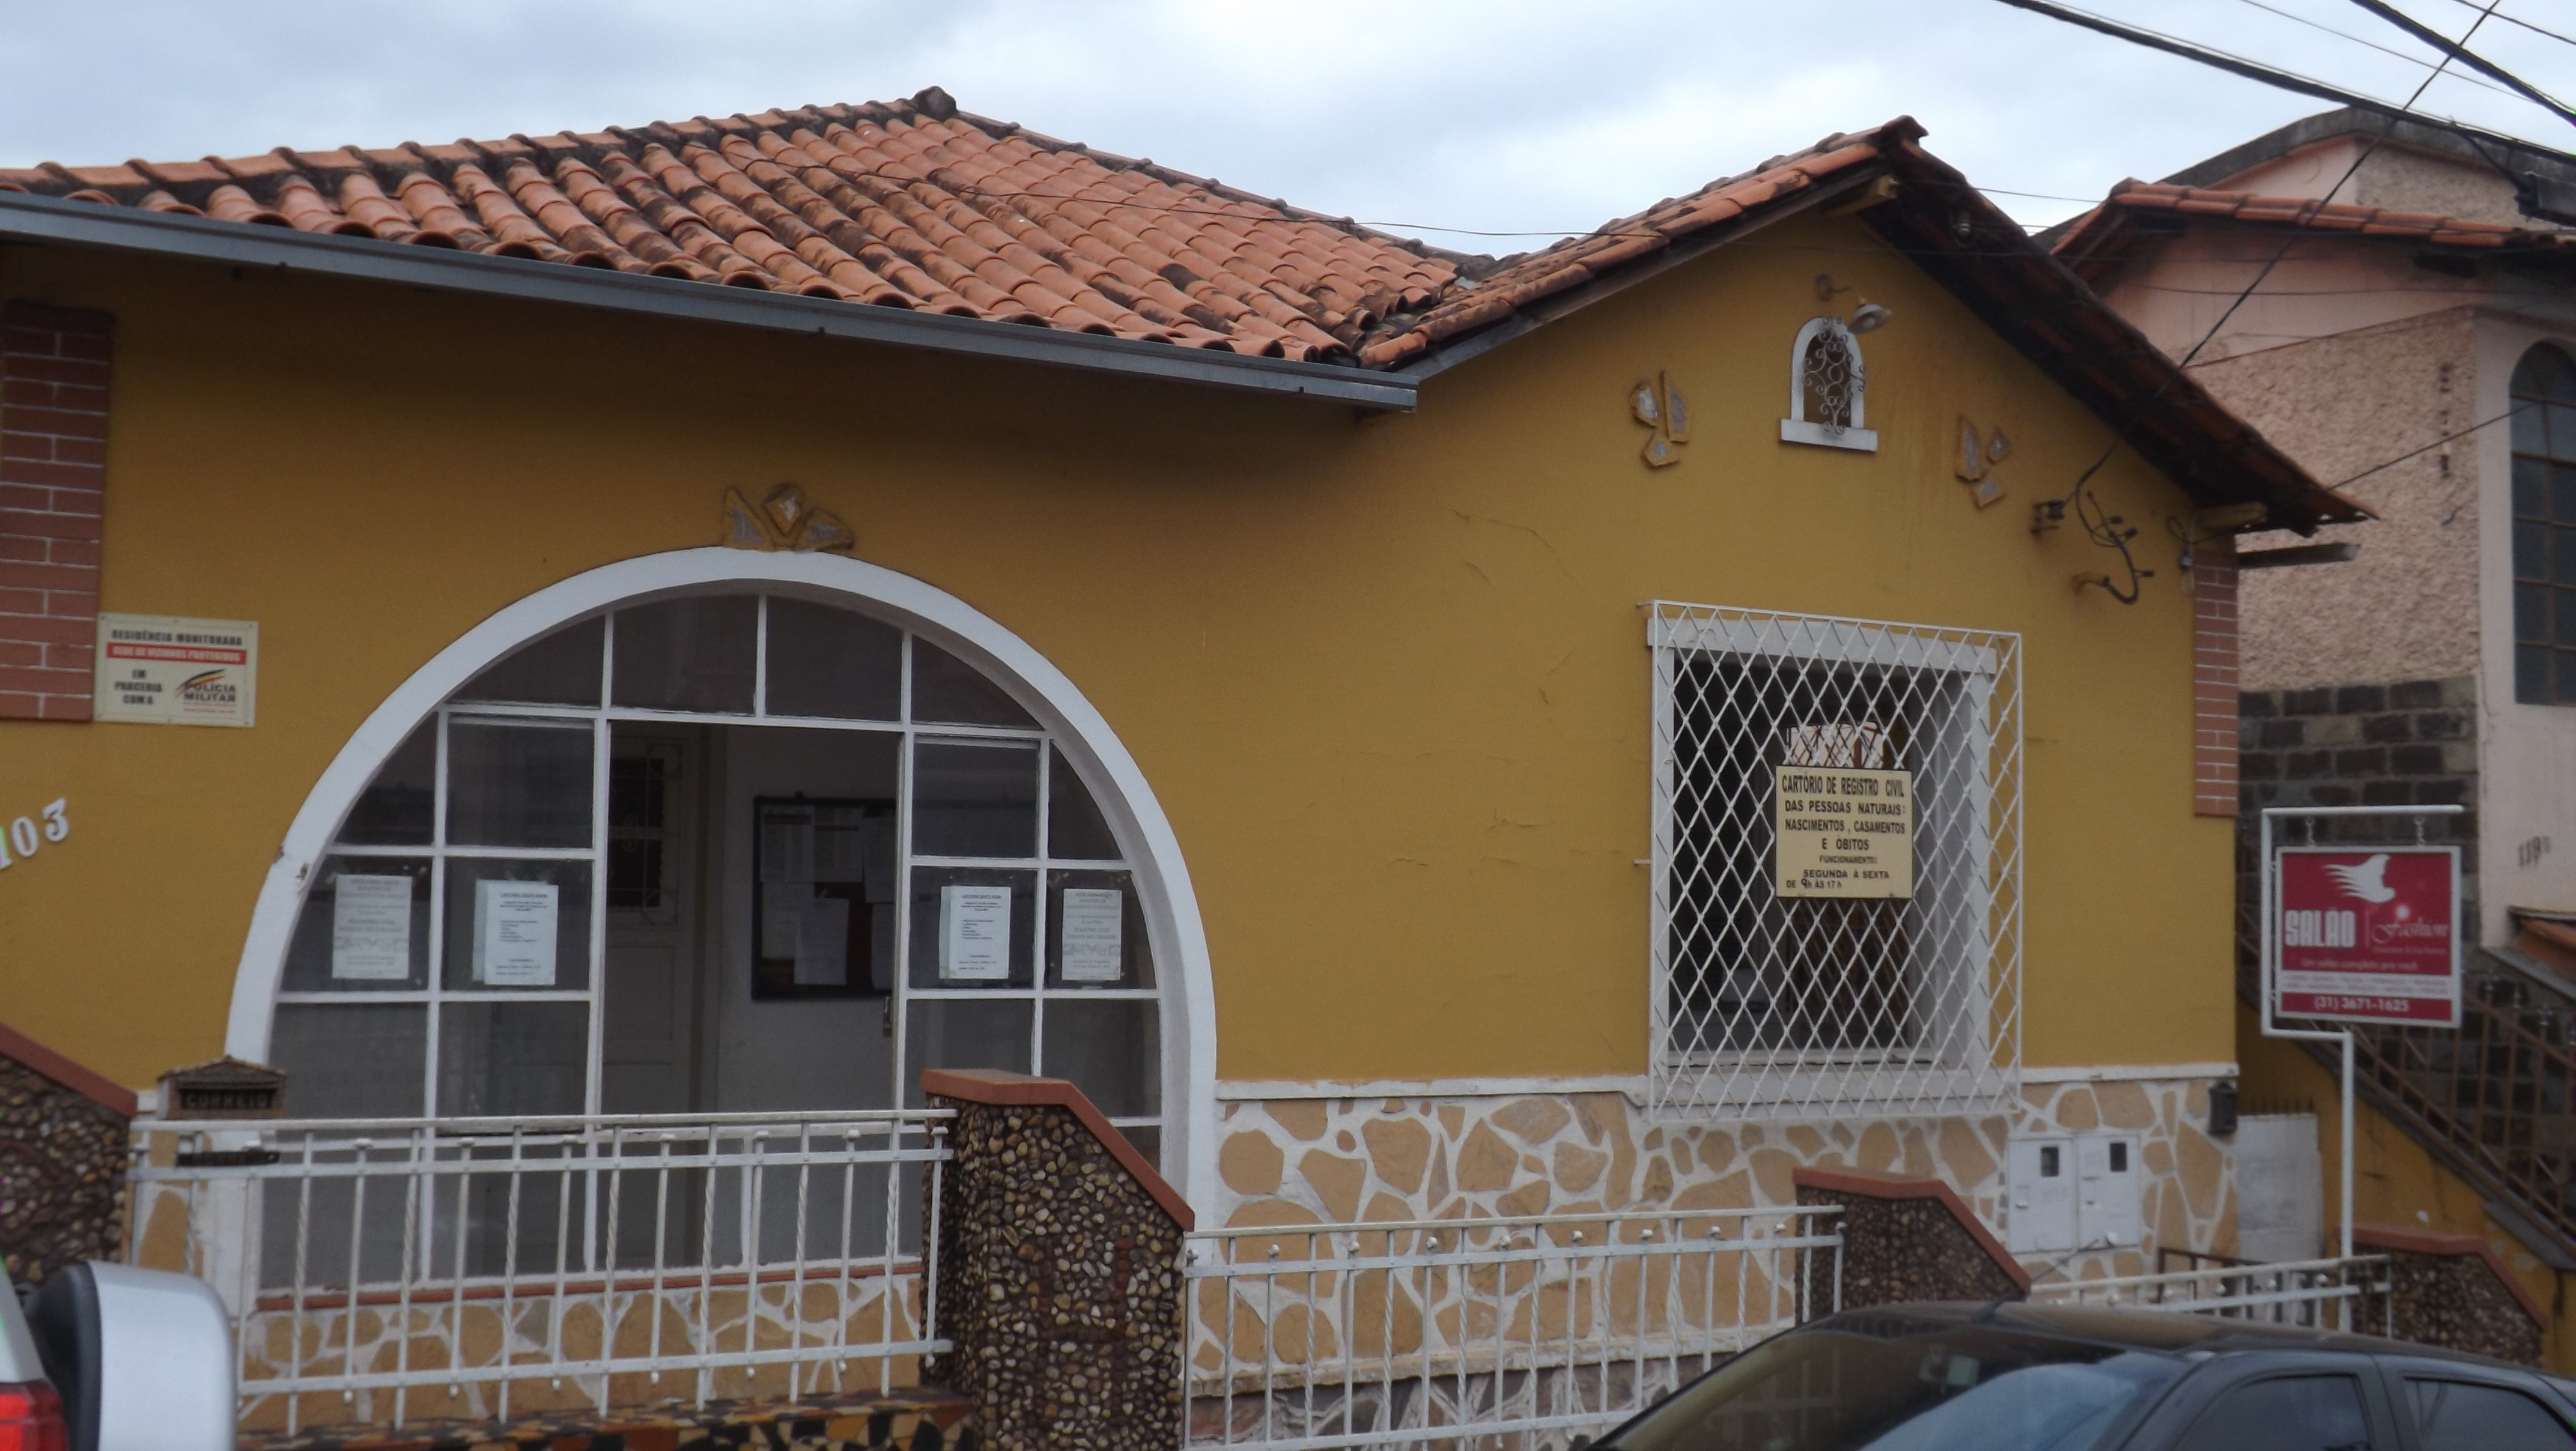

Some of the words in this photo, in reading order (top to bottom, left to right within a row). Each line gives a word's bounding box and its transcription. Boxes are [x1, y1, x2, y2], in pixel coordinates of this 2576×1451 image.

[184, 692, 236, 702] MILITAR
[1782, 772, 1823, 794] CARTÓRIO
[1826, 776, 1836, 795] DE
[1841, 777, 1879, 796] REGISTRO
[1885, 779, 1905, 798] CIVIL
[1785, 799, 1803, 812] DAS
[1809, 800, 1851, 813] PESSOAS
[1854, 820, 1906, 834] CASAMENTOS
[1821, 838, 1827, 850] E
[1803, 869, 1848, 878] SEGUNDA
[1863, 870, 1890, 879] SEXTA
[1786, 880, 1796, 888] DE
[186, 1092, 268, 1108] CORREIO
